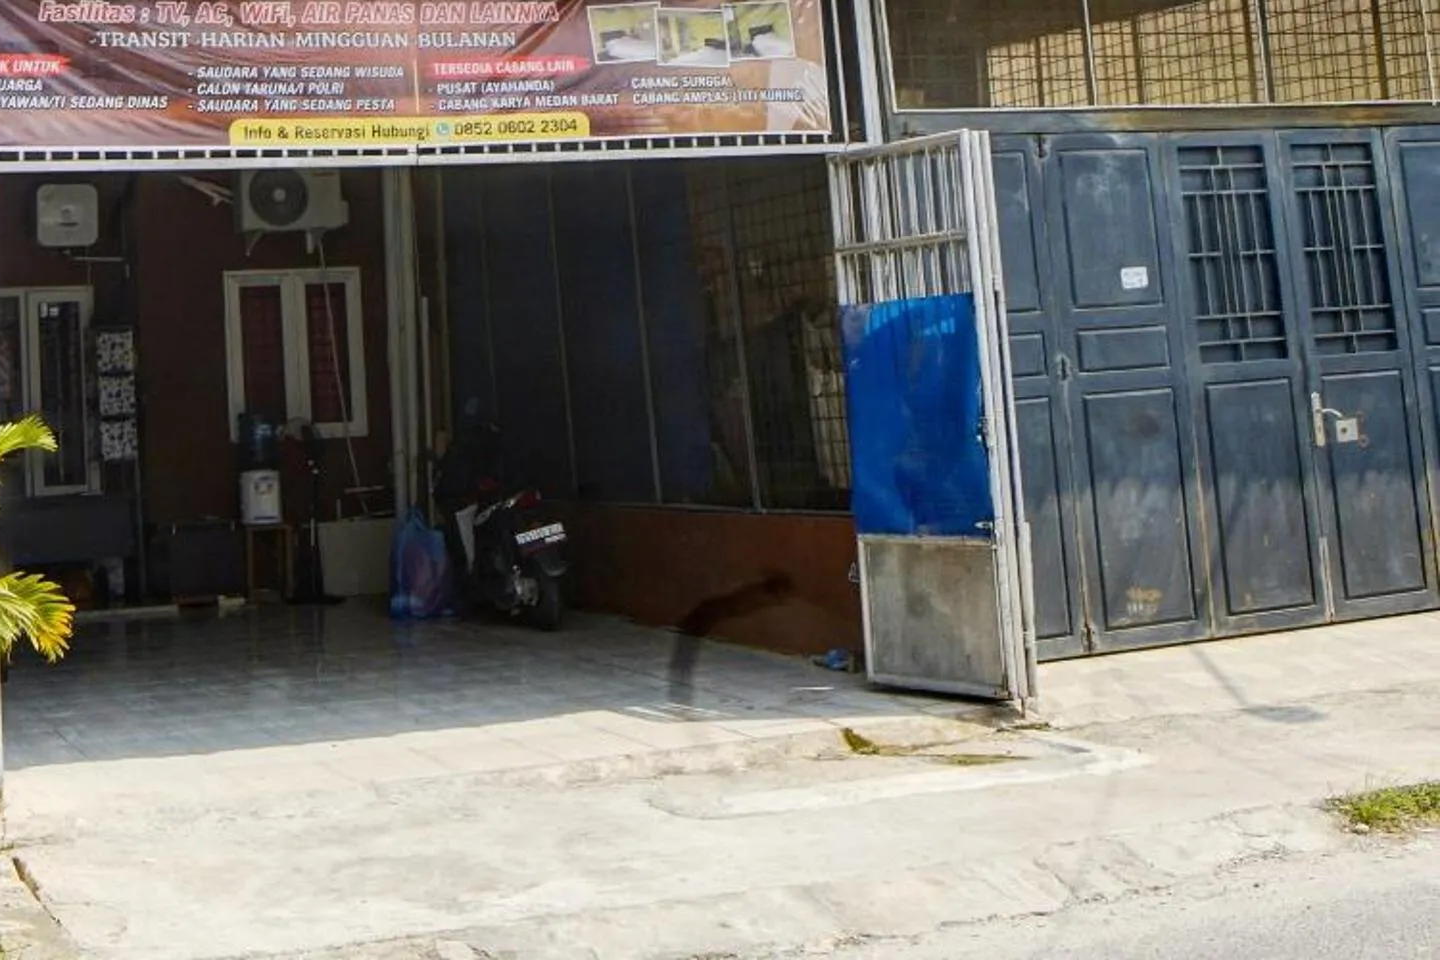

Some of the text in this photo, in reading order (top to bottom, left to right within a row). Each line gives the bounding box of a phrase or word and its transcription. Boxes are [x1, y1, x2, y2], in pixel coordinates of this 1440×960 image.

[38, 0, 135, 23] Fasilitas
[156, 1, 191, 27] TV,
[195, 1, 234, 28] AC,
[301, 1, 340, 24] AIR
[345, 1, 414, 24] PANAS
[420, 2, 465, 24] DAN
[470, 1, 560, 24] LAINNYA
[201, 32, 285, 48] HARIAN
[295, 32, 408, 48] MINGGUAN
[418, 32, 516, 48] BULANAN
[12, 59, 60, 73] UNTUK
[196, 65, 259, 79] SAUDARA
[262, 65, 297, 79] YANG
[300, 65, 351, 79] SEDANG
[196, 82, 240, 95] CALON
[307, 81, 345, 95] POLRI
[436, 81, 479, 95] PUSAT
[70, 95, 124, 109] SEDANG
[127, 95, 169, 109] DINAS
[196, 98, 259, 112] SAUDARA
[301, 98, 353, 112] SEDANG
[244, 126, 273, 139] Info
[277, 126, 289, 138] &
[295, 125, 366, 138] Reservasi
[371, 123, 430, 140] Hubungi
[454, 121, 493, 136] 0852
